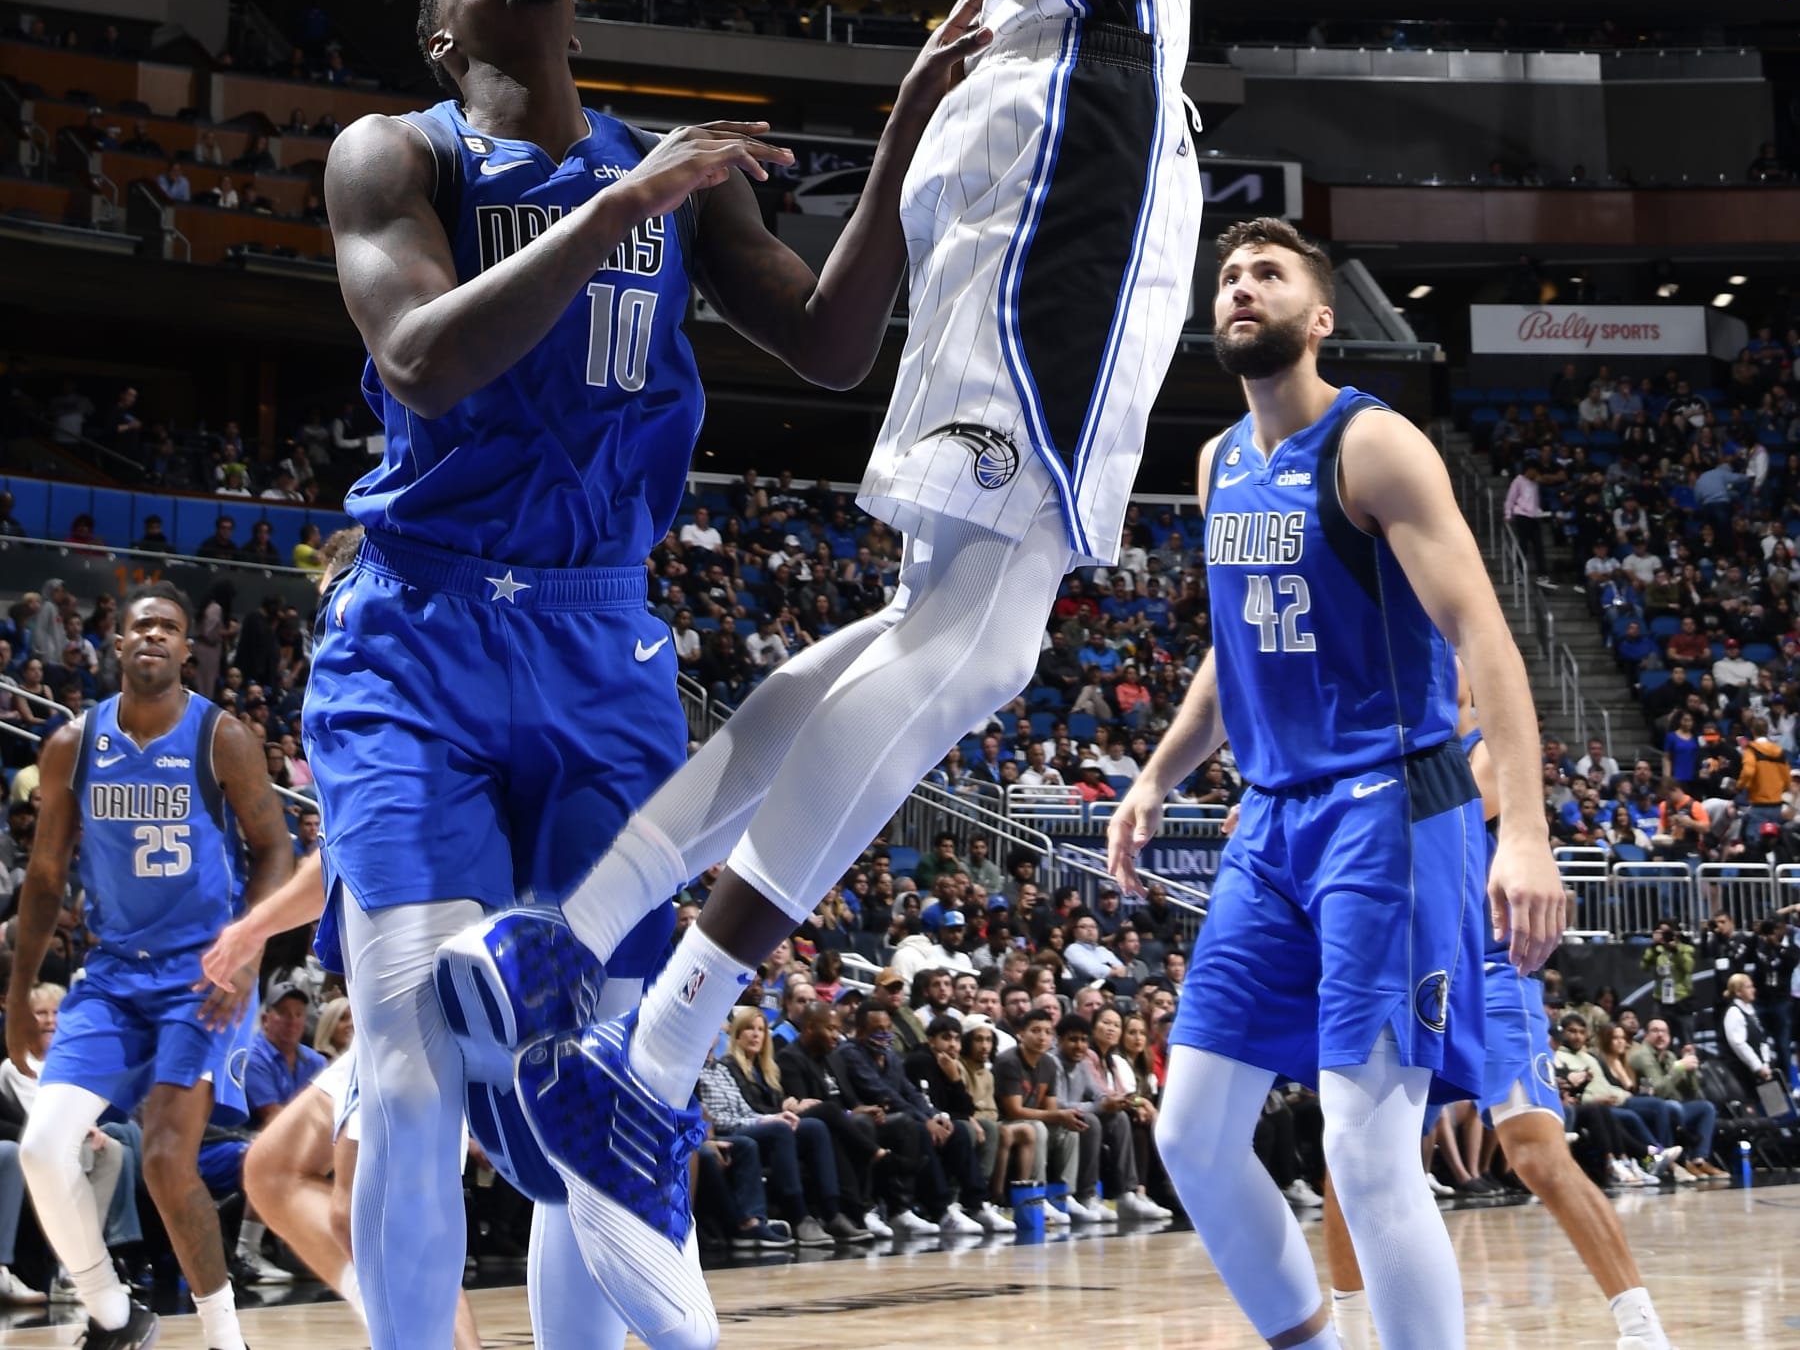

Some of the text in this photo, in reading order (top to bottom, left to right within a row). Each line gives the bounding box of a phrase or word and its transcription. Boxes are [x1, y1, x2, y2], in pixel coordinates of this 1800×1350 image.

[586, 282, 659, 392] 10
[1518, 310, 1660, 348] Bally SPORTS
[1224, 448, 1240, 466] 6
[1277, 470, 1311, 486] chime
[1207, 511, 1305, 566] DALLAS
[1244, 574, 1316, 652] 42
[97, 736, 110, 751] 6
[155, 756, 190, 768] chime
[91, 783, 191, 820] DALLAS
[134, 825, 192, 877] 25
